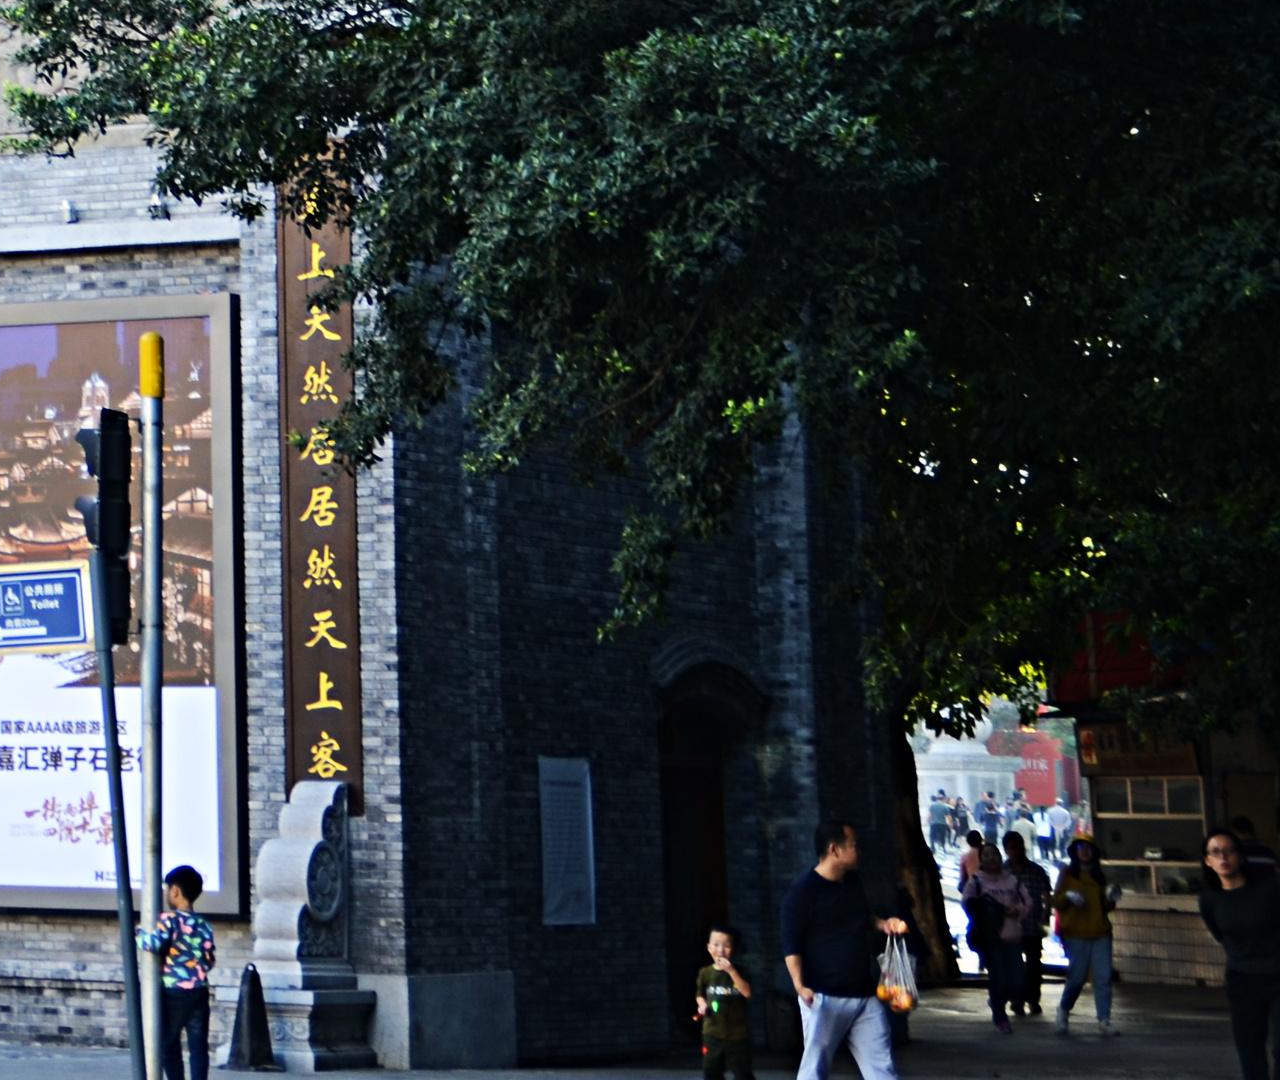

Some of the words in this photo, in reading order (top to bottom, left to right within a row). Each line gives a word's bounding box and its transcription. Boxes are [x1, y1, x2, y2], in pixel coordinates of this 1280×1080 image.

[29, 599, 60, 610] Toilet
[0, 719, 128, 735] 国家AAAA级旅游区
